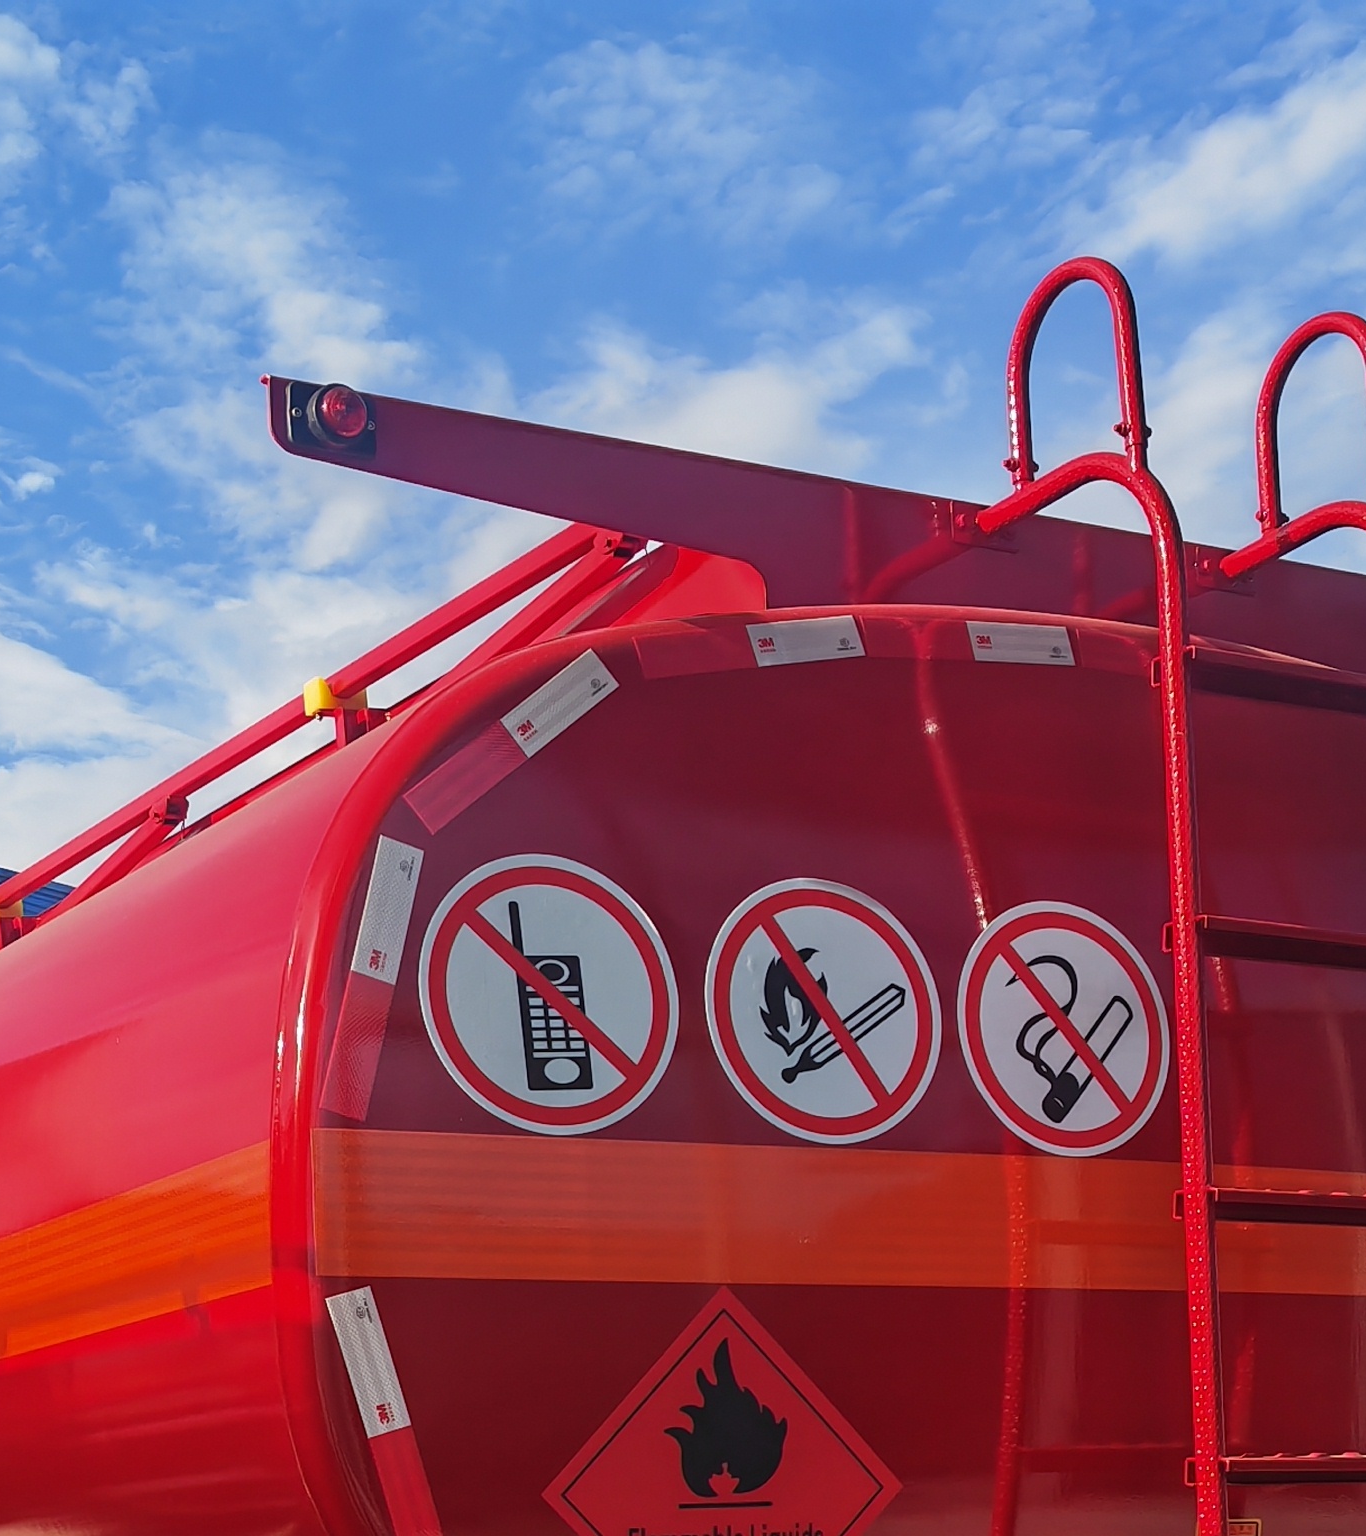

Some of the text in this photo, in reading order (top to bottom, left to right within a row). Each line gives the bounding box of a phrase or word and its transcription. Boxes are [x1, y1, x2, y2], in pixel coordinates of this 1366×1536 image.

[757, 637, 774, 649] 3M
[976, 635, 992, 645] 3M
[517, 719, 534, 736] 3M
[369, 949, 382, 970] 3M
[376, 1404, 389, 1424] 3M
